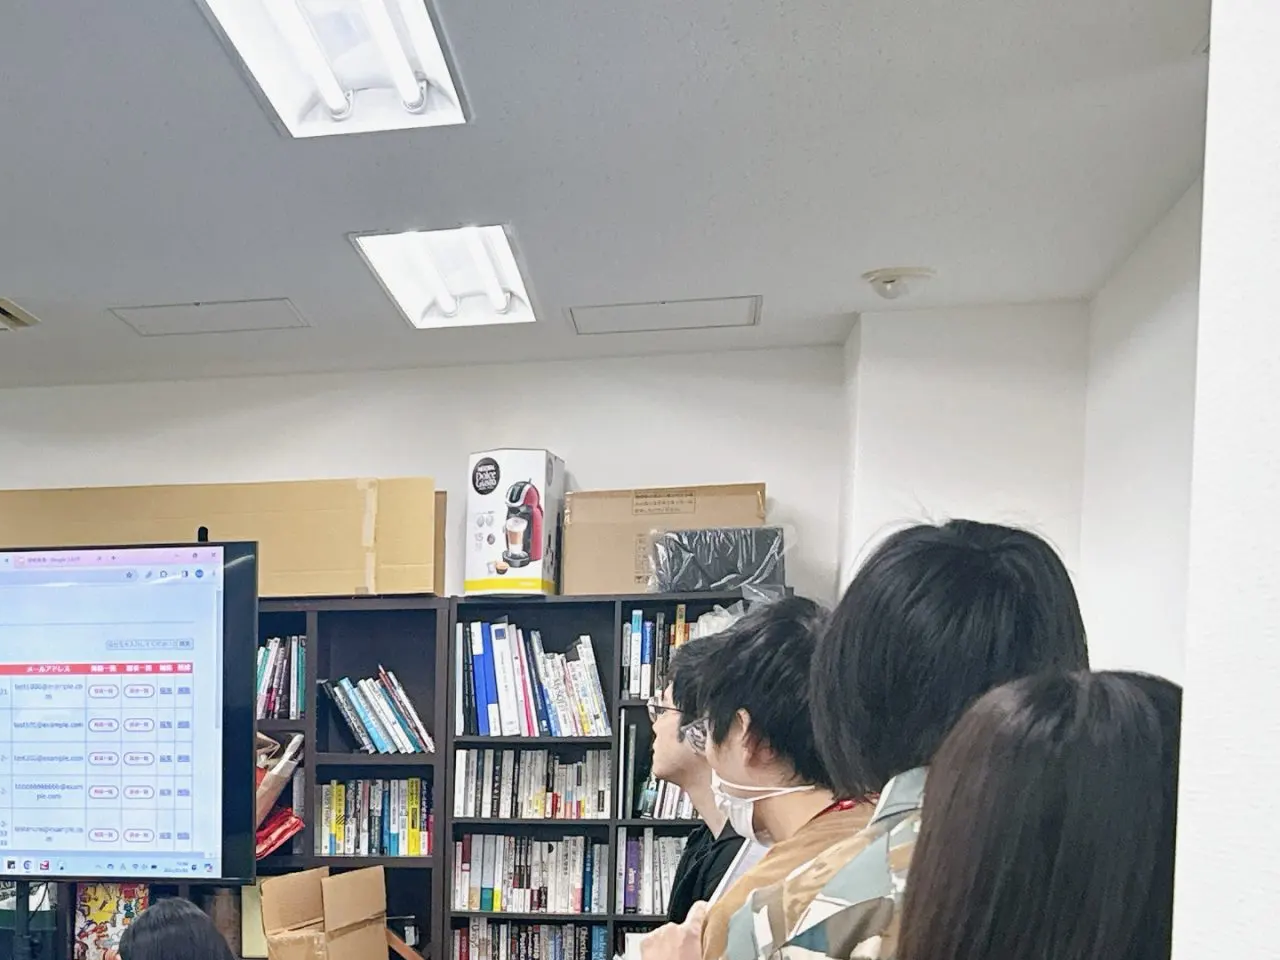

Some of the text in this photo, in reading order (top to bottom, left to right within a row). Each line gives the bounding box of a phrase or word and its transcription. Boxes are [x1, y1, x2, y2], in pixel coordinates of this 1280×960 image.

[27, 665, 71, 673] メールアドレス
